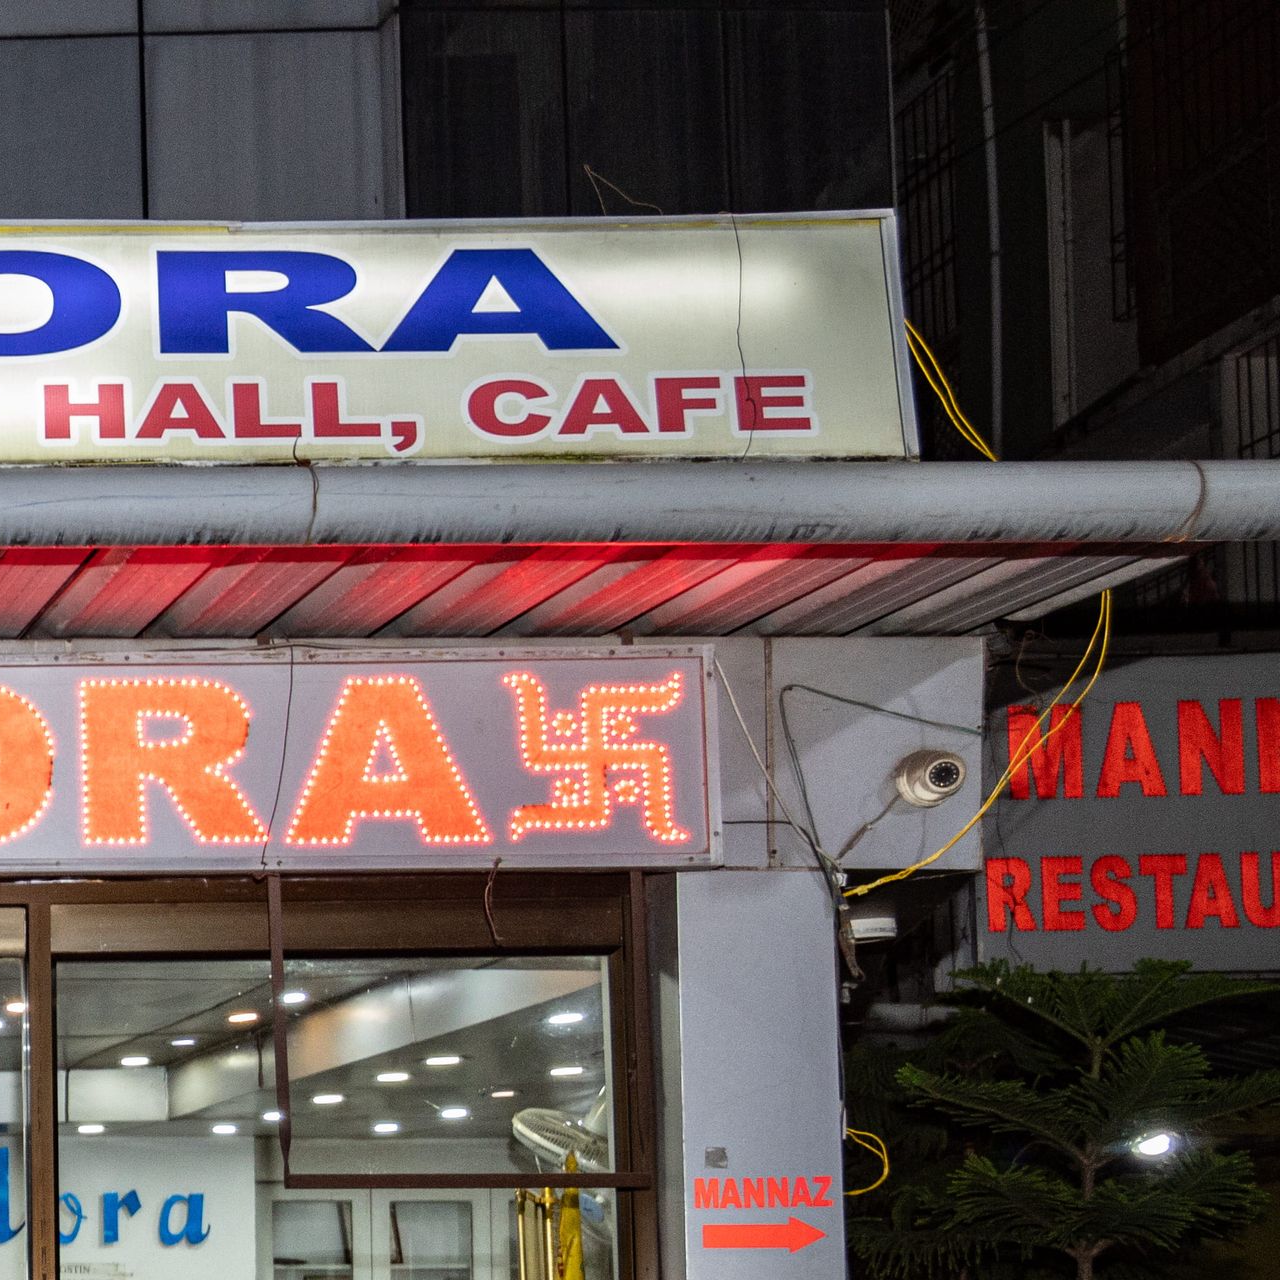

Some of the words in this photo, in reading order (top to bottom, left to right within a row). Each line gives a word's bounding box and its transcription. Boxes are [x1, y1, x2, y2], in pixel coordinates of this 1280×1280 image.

[44, 381, 417, 452] HALL,
[468, 375, 812, 437] CAFE
[693, 1175, 834, 1209] MANNAZ
